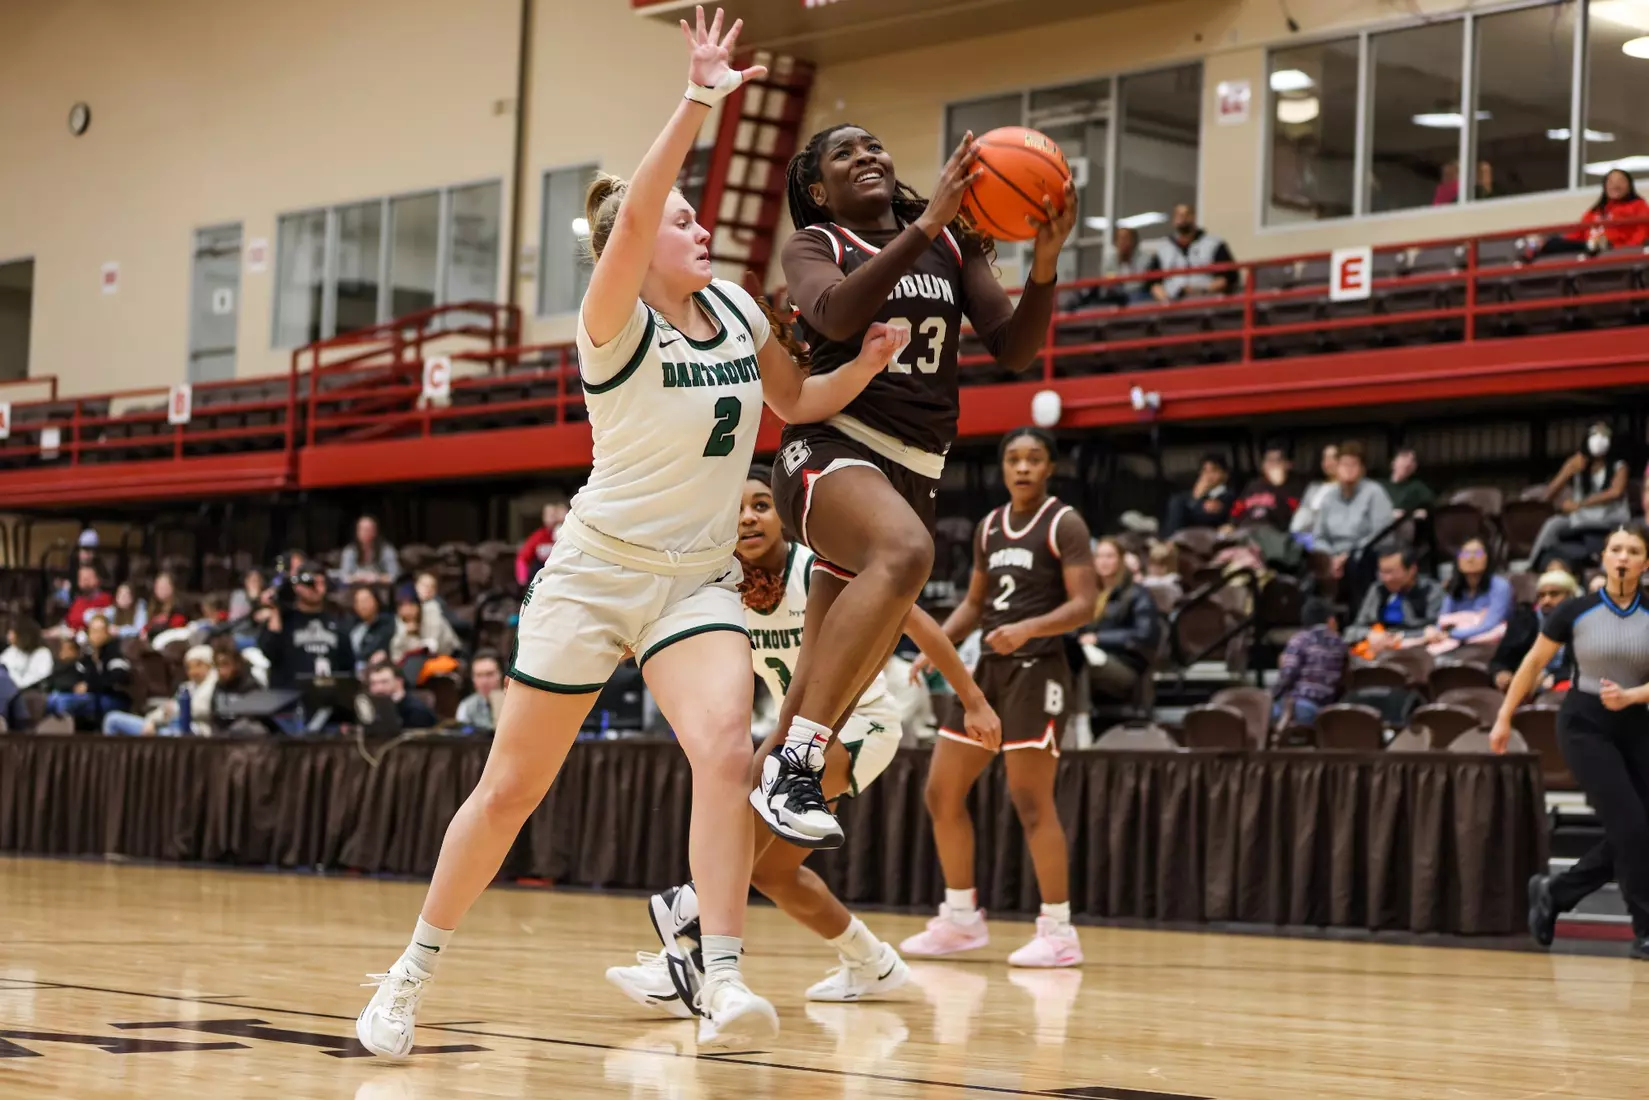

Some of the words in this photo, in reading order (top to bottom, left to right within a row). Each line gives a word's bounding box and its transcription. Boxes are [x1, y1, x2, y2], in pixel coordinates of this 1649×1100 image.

[887, 274, 955, 305] ROWN
[1340, 257, 1363, 290] E
[887, 317, 947, 374] 23
[430, 363, 446, 388] C
[702, 396, 742, 457] 2
[780, 439, 812, 477] B
[993, 574, 1016, 611] 2
[749, 627, 804, 650] TMOUT
[1043, 679, 1064, 715] B
